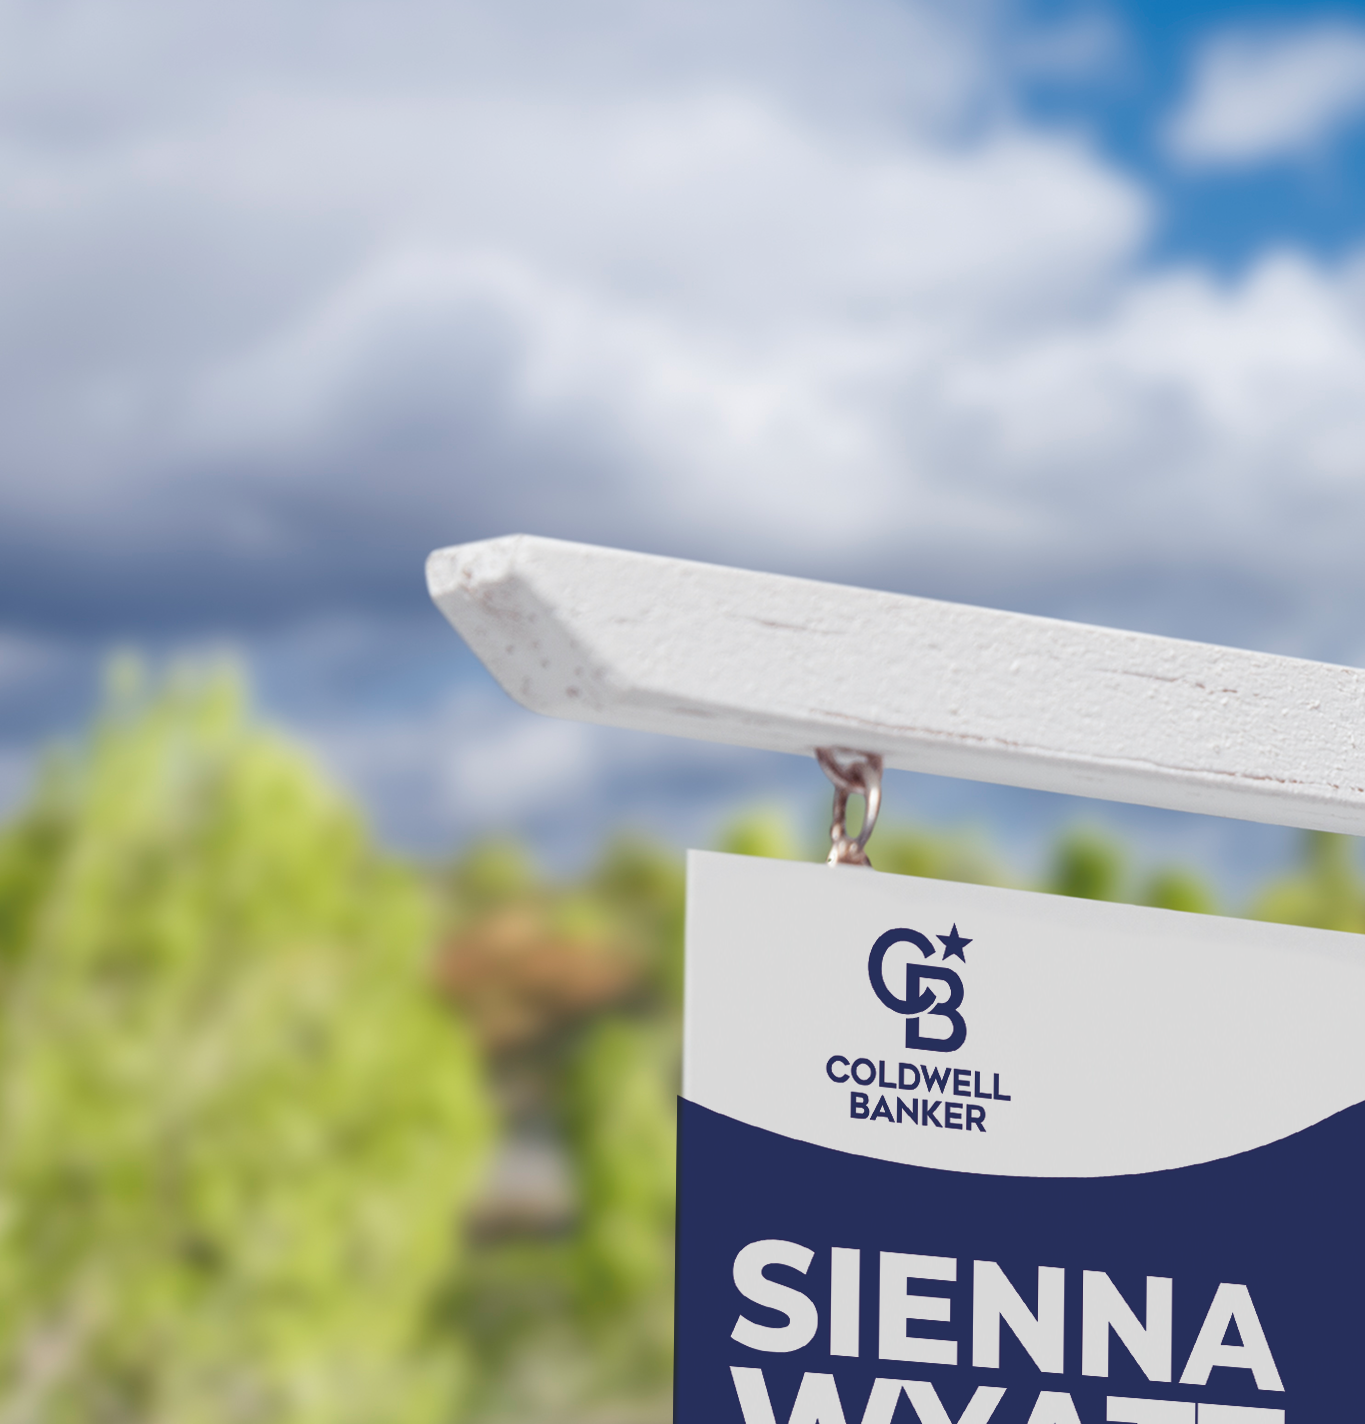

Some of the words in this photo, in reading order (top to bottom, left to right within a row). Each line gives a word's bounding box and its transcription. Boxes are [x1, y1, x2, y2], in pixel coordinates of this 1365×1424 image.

[826, 1055, 1011, 1101] COLDWELL
[850, 1091, 986, 1133] BANKER
[730, 1238, 1286, 1392] SIENNA
